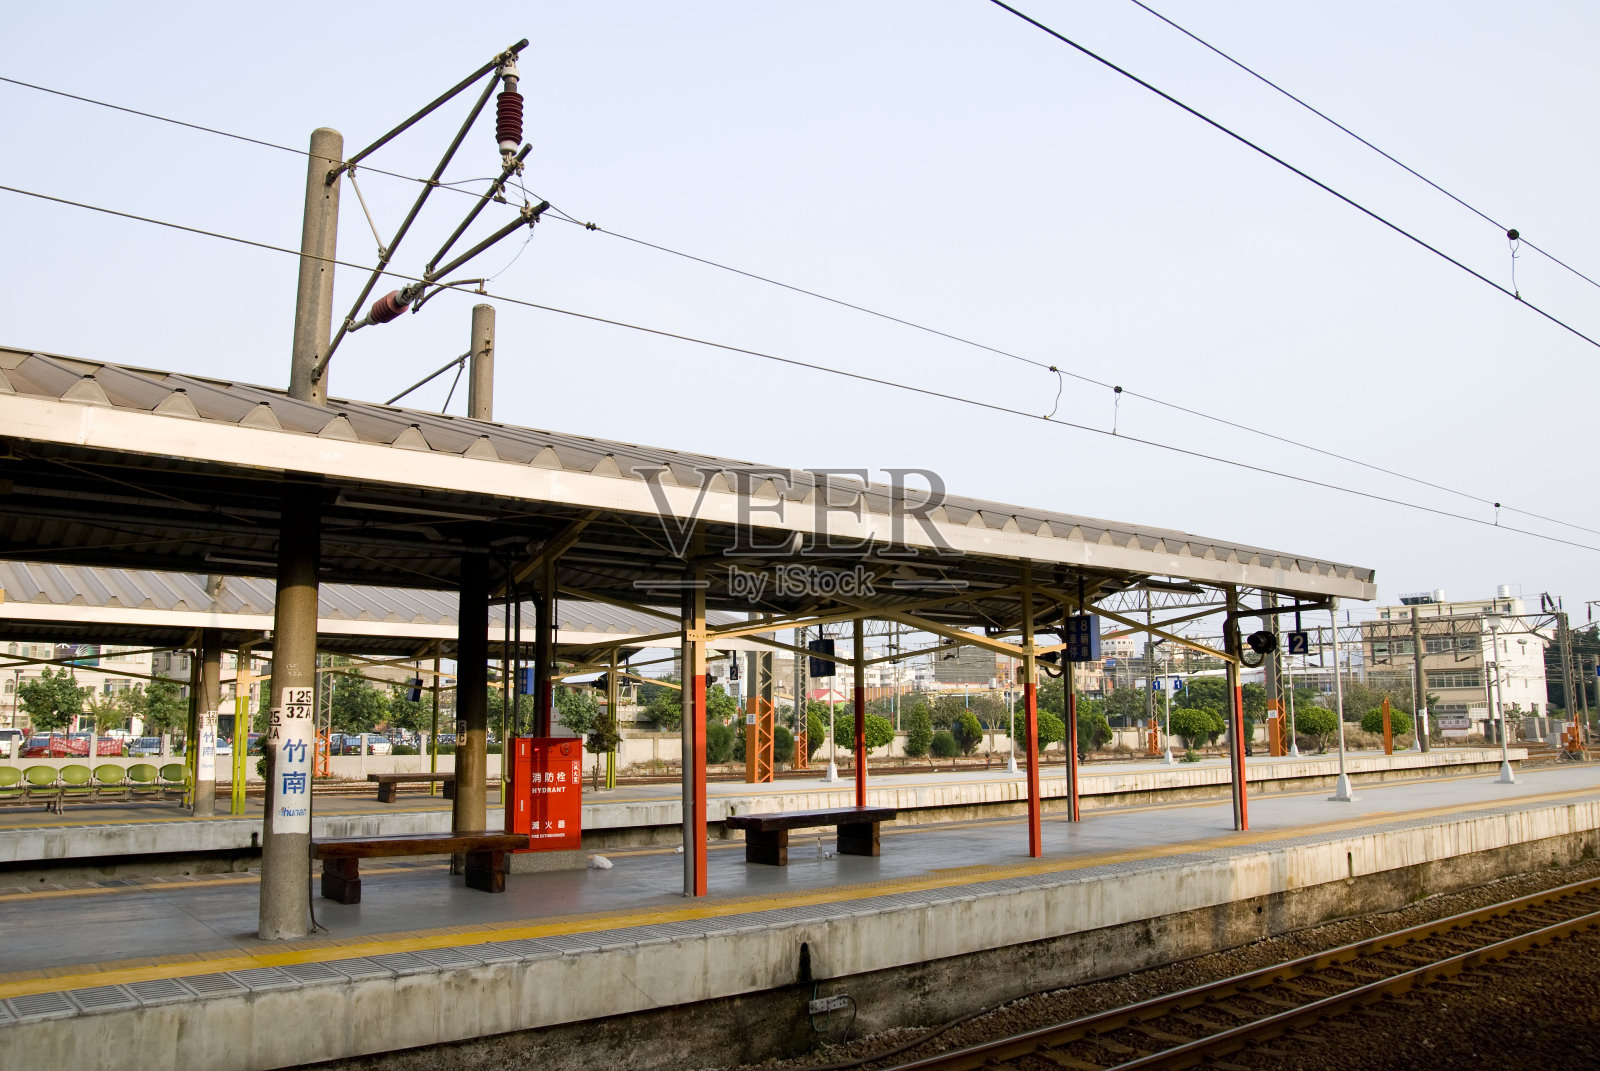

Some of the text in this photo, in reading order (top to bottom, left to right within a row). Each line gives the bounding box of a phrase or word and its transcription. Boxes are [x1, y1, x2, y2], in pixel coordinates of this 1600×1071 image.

[1293, 635, 1304, 652] 2
[731, 668, 737, 679] 2
[288, 690, 312, 703] 125
[286, 706, 311, 719] 32A
[282, 738, 308, 795] 竹南
[532, 771, 566, 783] 消防栓
[531, 819, 566, 830] 滅火器
